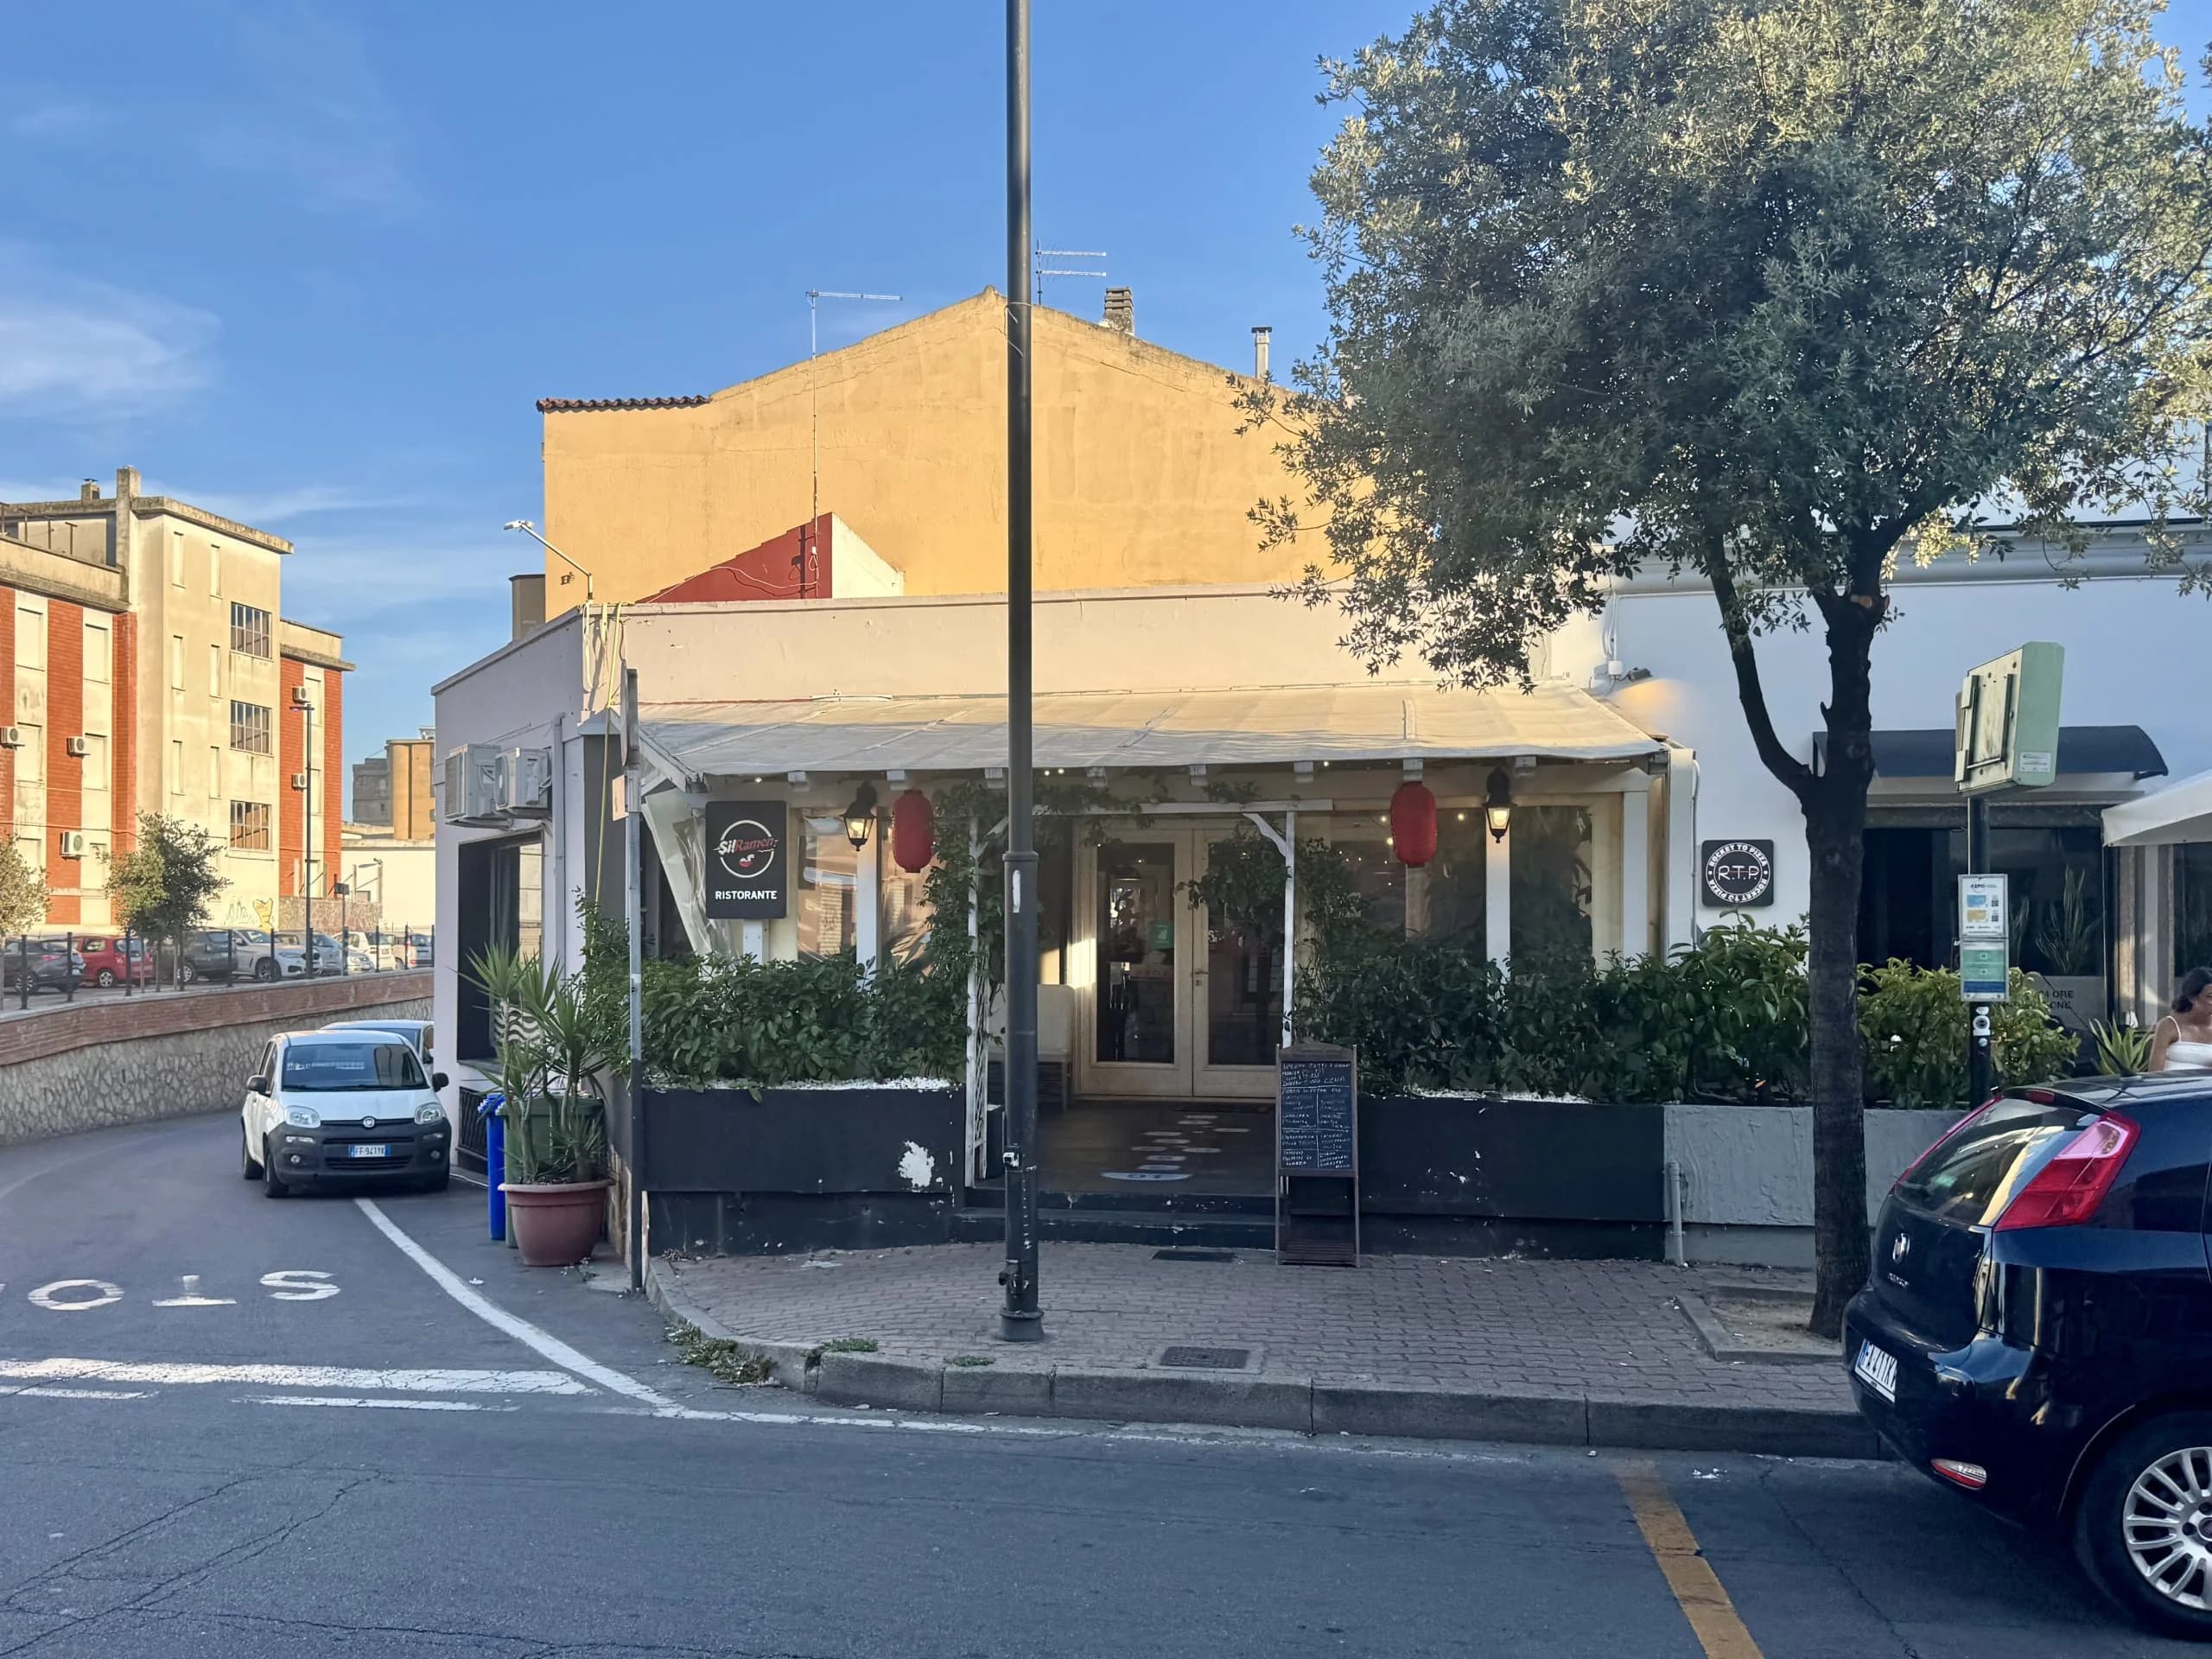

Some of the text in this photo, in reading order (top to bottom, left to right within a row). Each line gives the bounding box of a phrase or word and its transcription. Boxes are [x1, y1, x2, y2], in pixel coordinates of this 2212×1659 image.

[1709, 844, 1735, 867] ROCKET
[1750, 848, 1769, 867] PIZZA
[715, 890, 778, 899] RISTORANTE
[0, 1269, 341, 1311] STO
